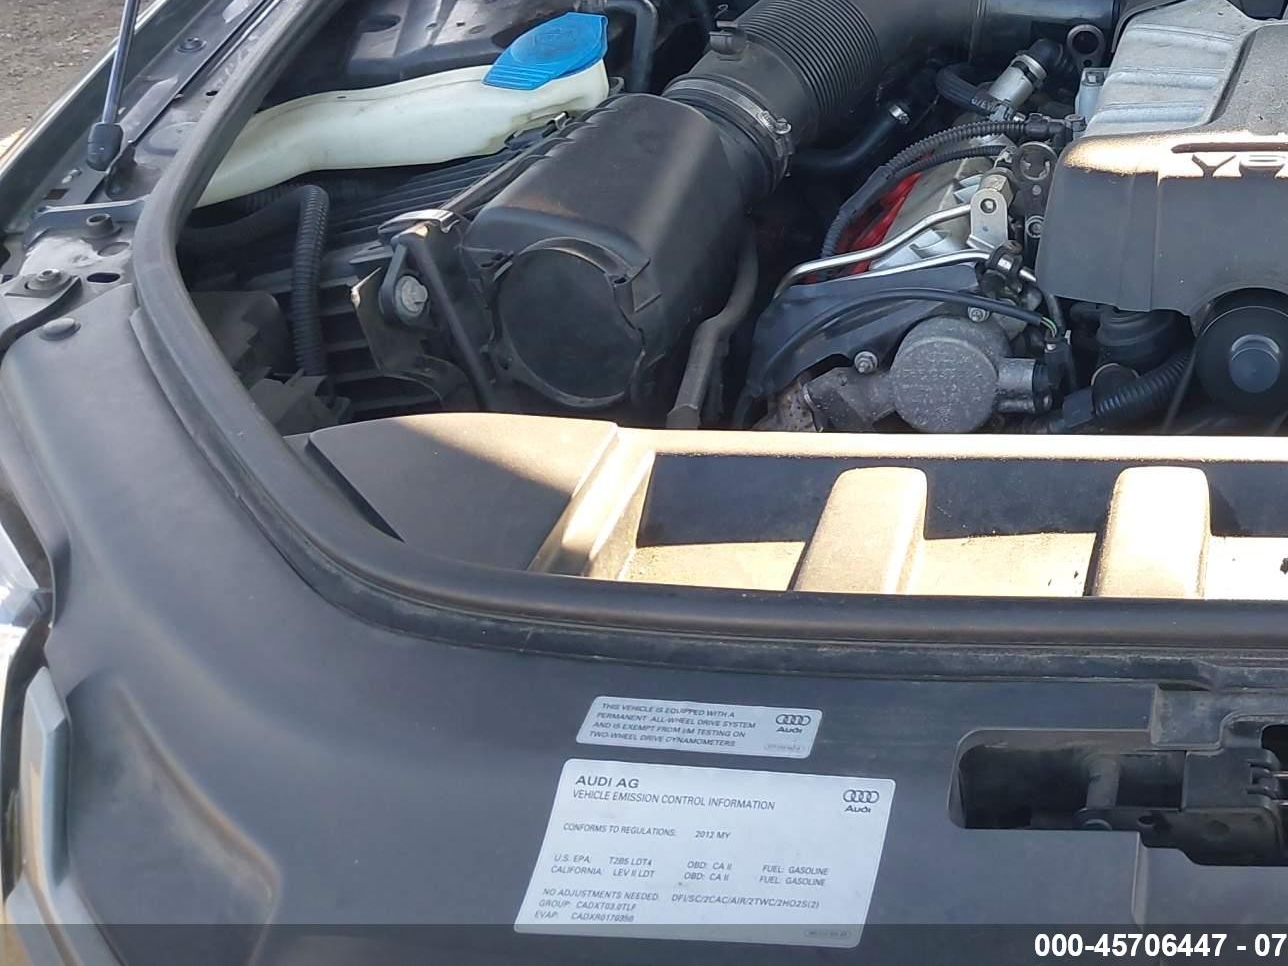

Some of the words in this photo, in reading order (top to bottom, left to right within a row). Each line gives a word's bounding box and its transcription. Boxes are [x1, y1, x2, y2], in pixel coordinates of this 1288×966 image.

[602, 702, 620, 710] THIS
[622, 704, 653, 712] VEHICLE
[665, 706, 704, 716] EQUIPPED
[596, 712, 646, 722] PERMANENT
[722, 720, 756, 728] SYSTEM
[622, 724, 655, 732] EXEMPT
[656, 726, 680, 734] FROM
[697, 728, 730, 737] TESTING
[732, 730, 746, 738] ON
[776, 726, 802, 734] Audi
[640, 734, 664, 742] DRIVE
[665, 736, 736, 746] DYNAMOMETERS
[575, 775, 613, 787] AUDI
[616, 778, 640, 789] AG
[572, 789, 610, 800] VEHICLE
[612, 792, 660, 804] EMISSION
[662, 794, 706, 806] CONTROL
[708, 797, 776, 810] INFORMATION
[844, 804, 872, 814] Audi
[562, 822, 607, 833] CONFORMS
[609, 825, 620, 834] TO
[696, 830, 715, 839] 2012
[716, 831, 731, 840] MY
[631, 858, 652, 866] LDT4
[712, 862, 725, 870] CA
[726, 862, 732, 870] II
[612, 869, 630, 877] LEV
[638, 870, 655, 878] LDT
[788, 866, 829, 876] GASOLINE
[709, 874, 721, 882] CA
[723, 874, 729, 882] II
[785, 877, 826, 887] GASOLINE
[543, 888, 556, 896] NO
[558, 889, 622, 900] ADJUSTMENTS
